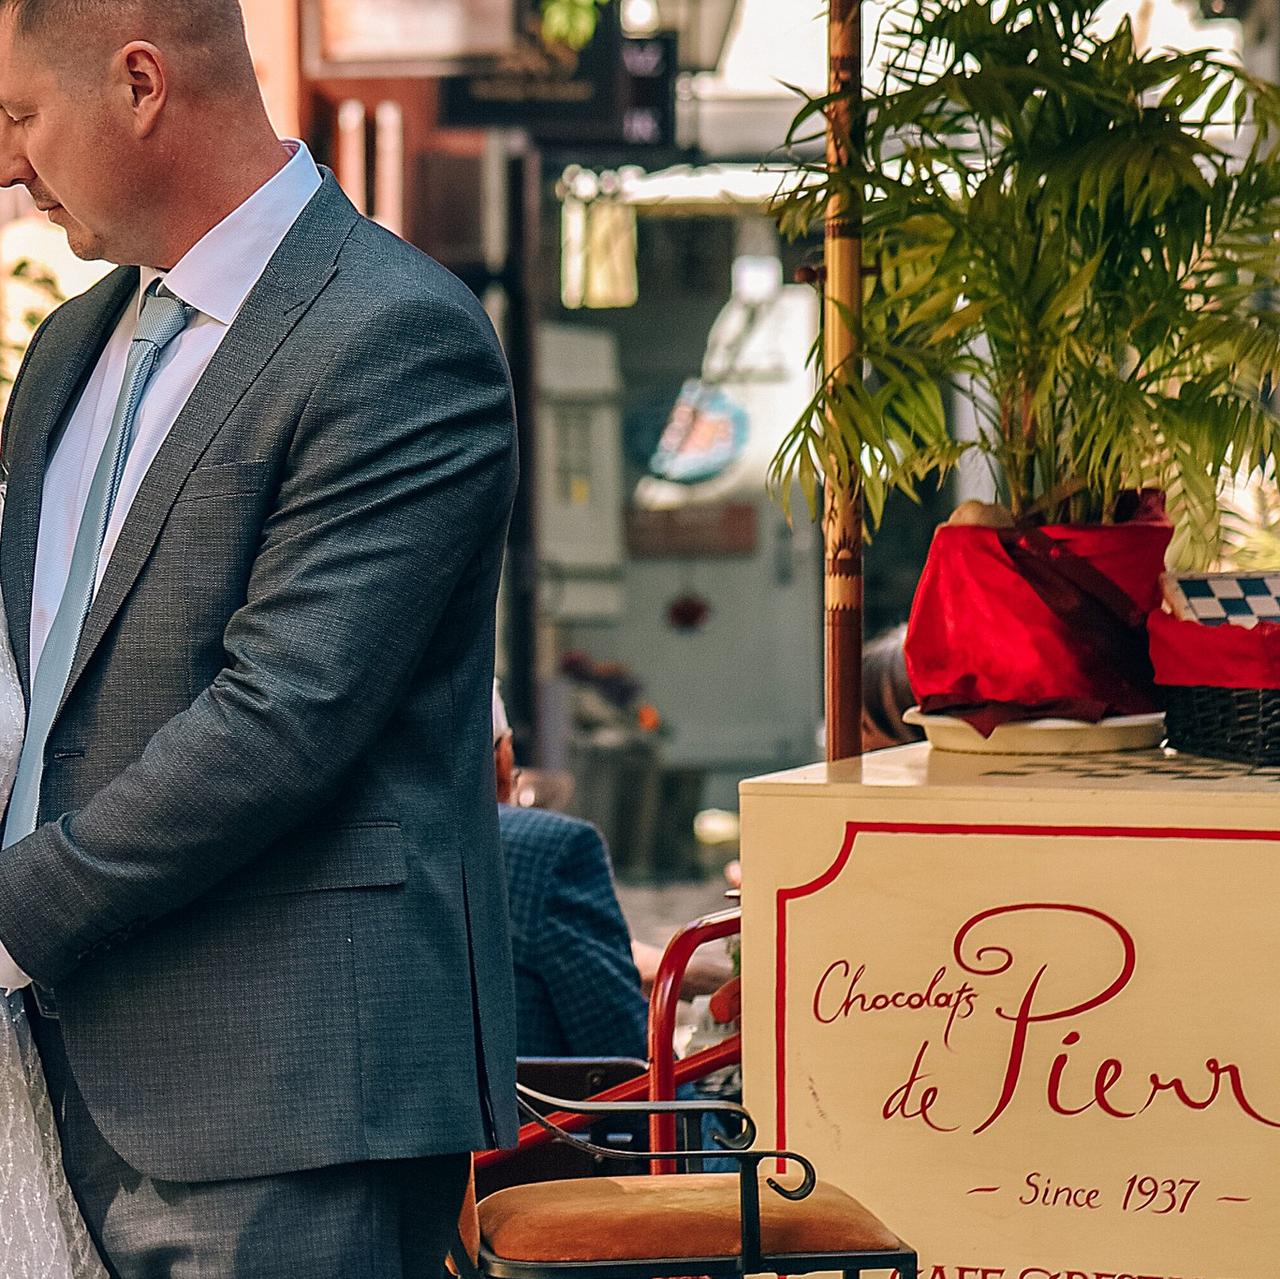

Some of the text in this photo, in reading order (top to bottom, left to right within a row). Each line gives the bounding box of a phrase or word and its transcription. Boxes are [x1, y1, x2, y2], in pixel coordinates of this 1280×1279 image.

[813, 959, 980, 1053] Chocolats
[882, 902, 1280, 1135] de Pierr
[1018, 1172, 1201, 1214] Since 1937
